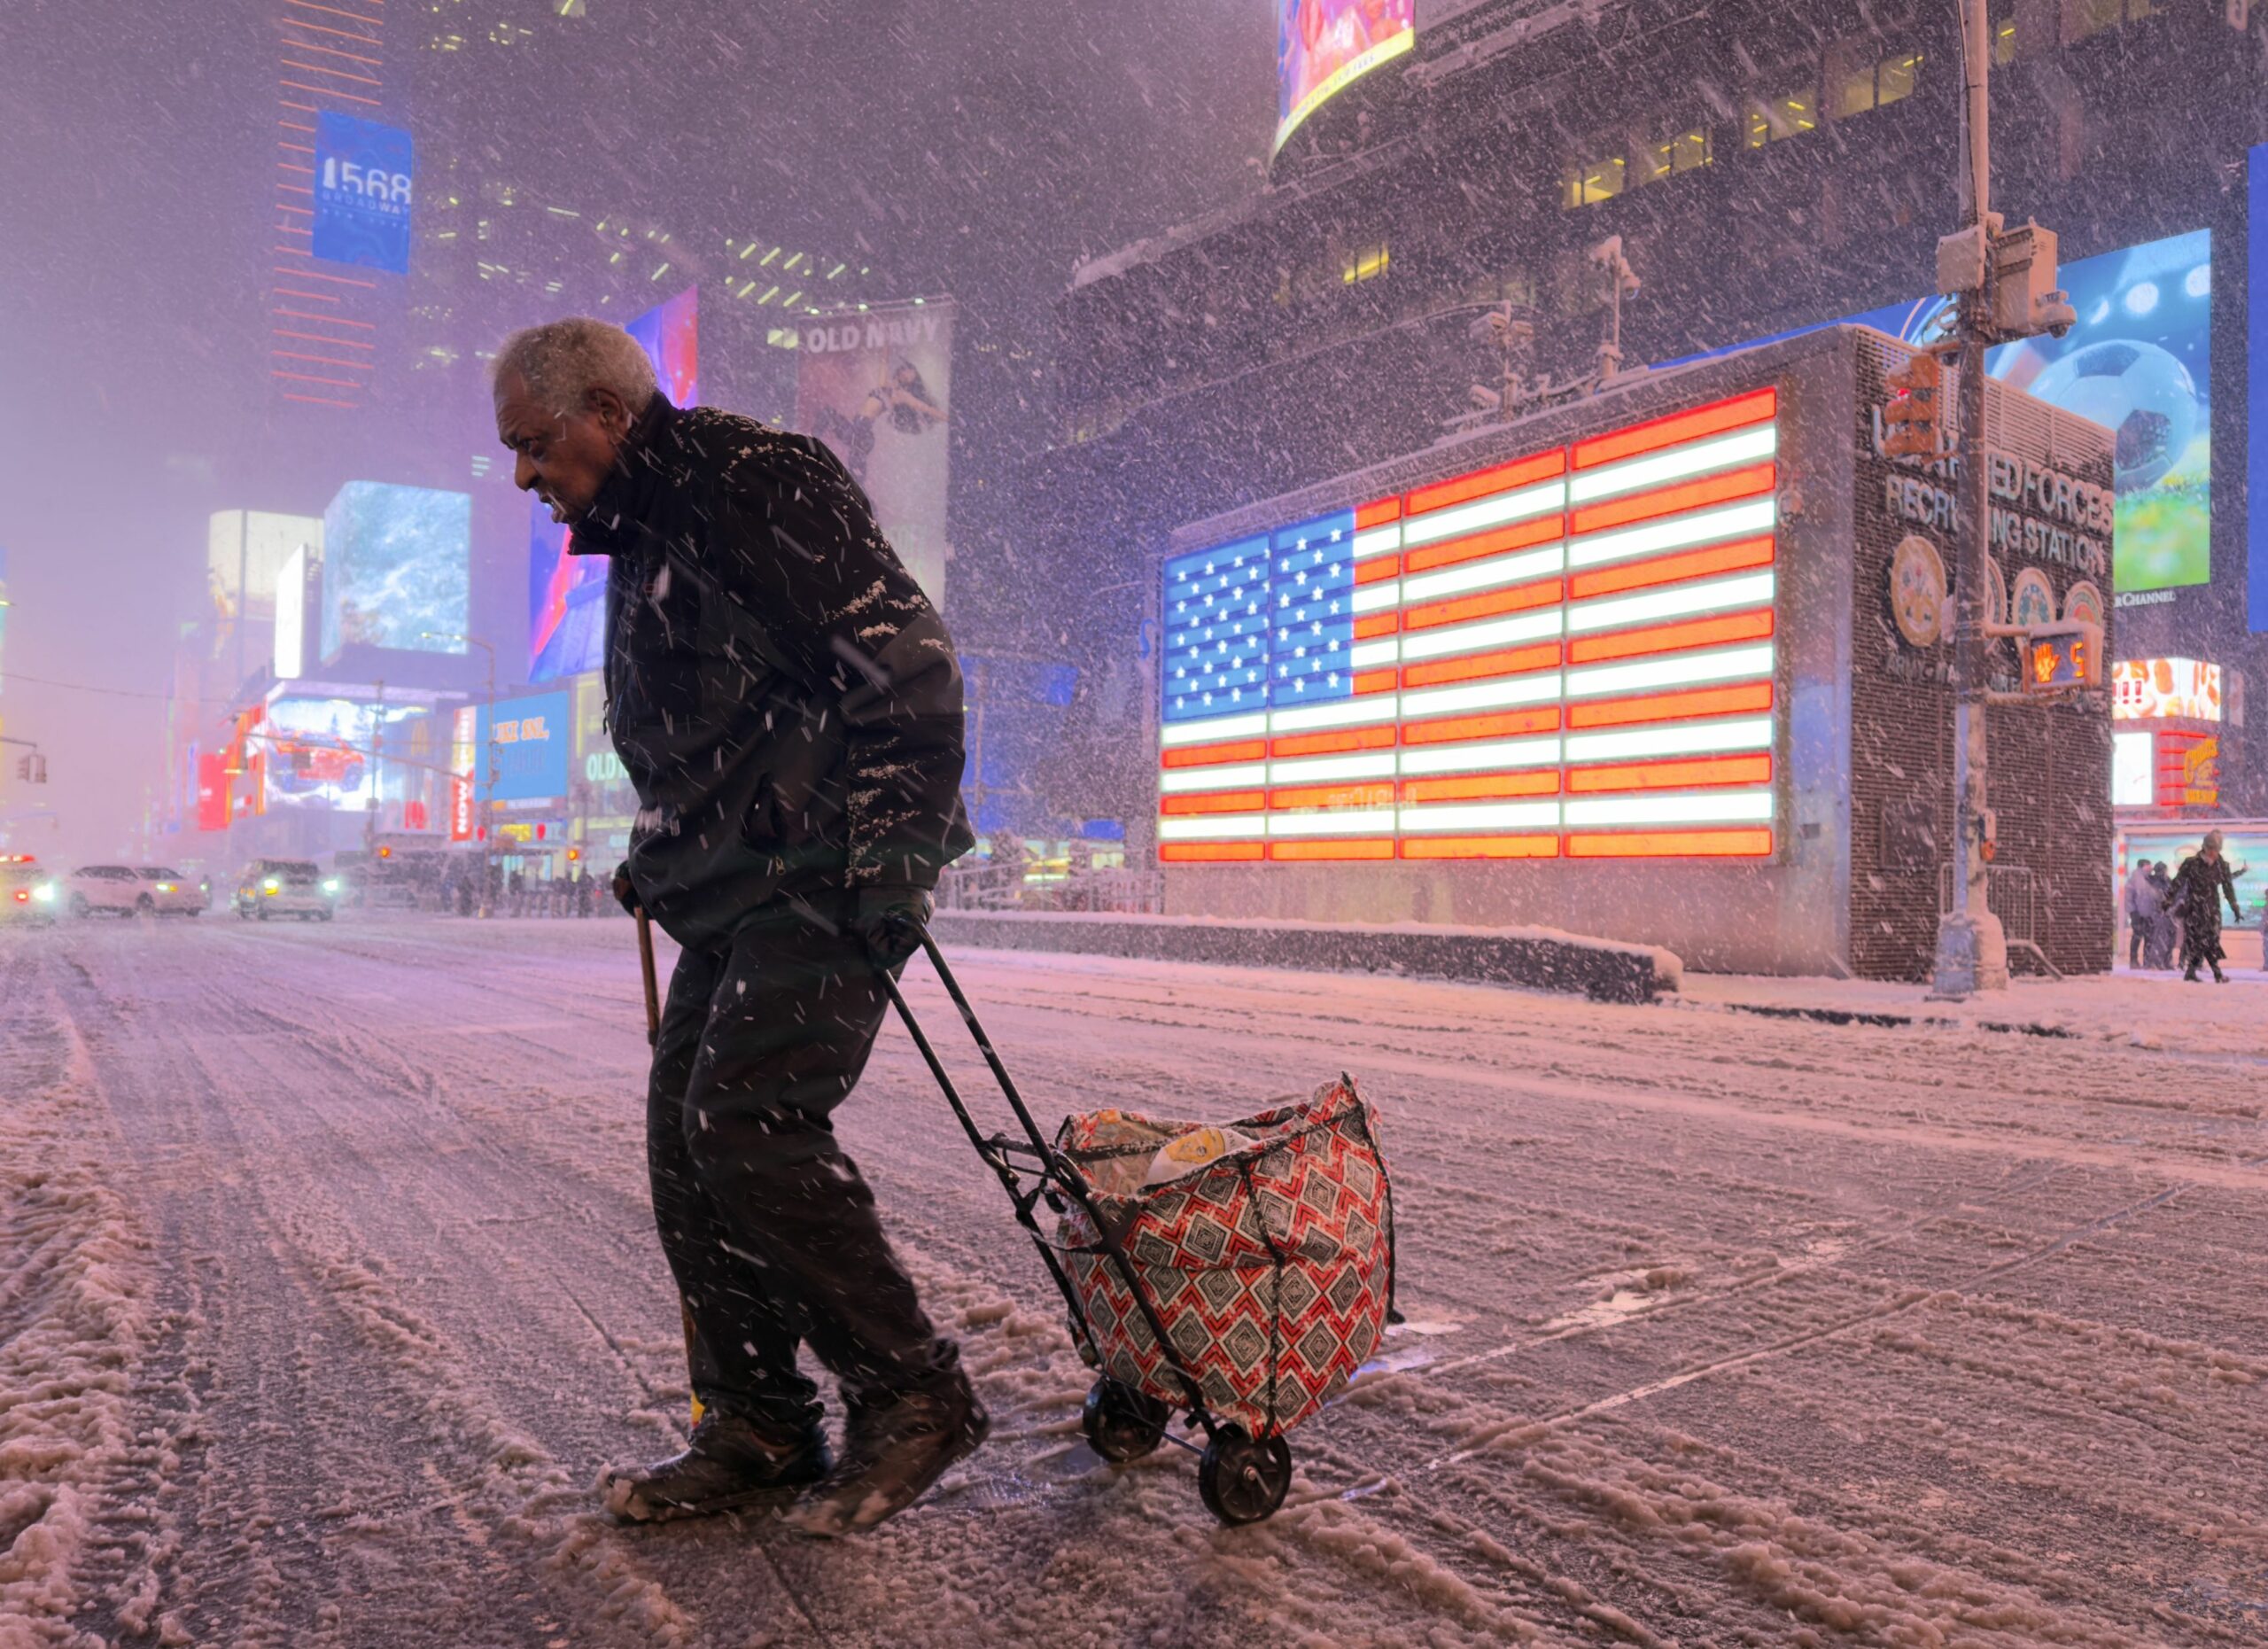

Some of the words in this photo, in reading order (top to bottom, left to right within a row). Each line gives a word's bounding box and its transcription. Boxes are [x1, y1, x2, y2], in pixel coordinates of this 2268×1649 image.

[322, 157, 411, 205] 1568
[807, 328, 859, 354] OLD
[866, 316, 940, 349] NAVY
[2023, 457, 2114, 534] FORCES
[2023, 517, 2106, 575] STATION
[2123, 590, 2177, 607] CHANNEL
[2070, 641, 2085, 678] 5
[586, 753, 616, 781] OLD
[456, 781, 469, 834] NOW
